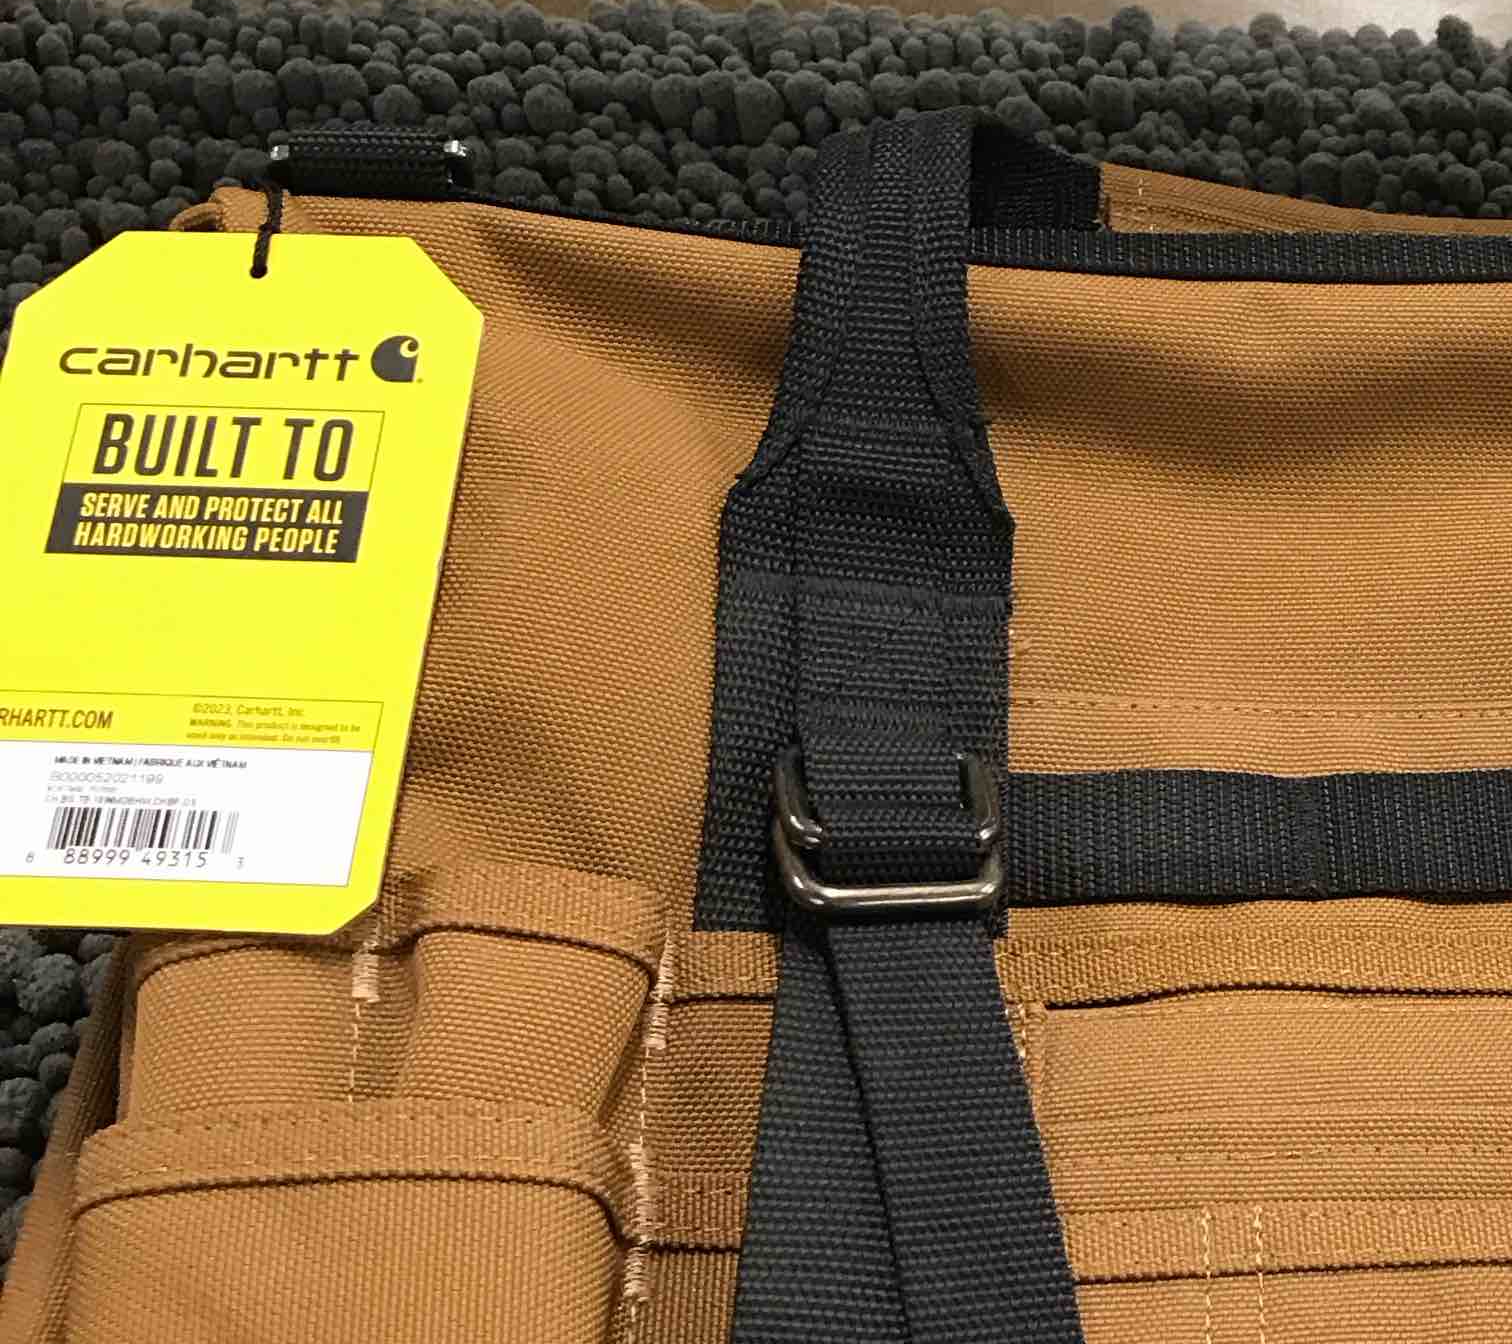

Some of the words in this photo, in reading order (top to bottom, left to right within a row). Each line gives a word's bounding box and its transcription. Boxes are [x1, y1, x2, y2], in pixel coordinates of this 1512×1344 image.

[59, 343, 360, 382] carhartt
[92, 413, 262, 478] BUILT
[283, 417, 355, 482] TO
[80, 492, 149, 519] SERVE
[153, 494, 199, 520] AND
[204, 496, 304, 524] PROTECT
[307, 499, 343, 525] ALL
[73, 522, 248, 552] HARDWORKING
[253, 527, 340, 555] PEOPLE
[63, 848, 131, 866] 88999
[141, 850, 209, 869] 49315
